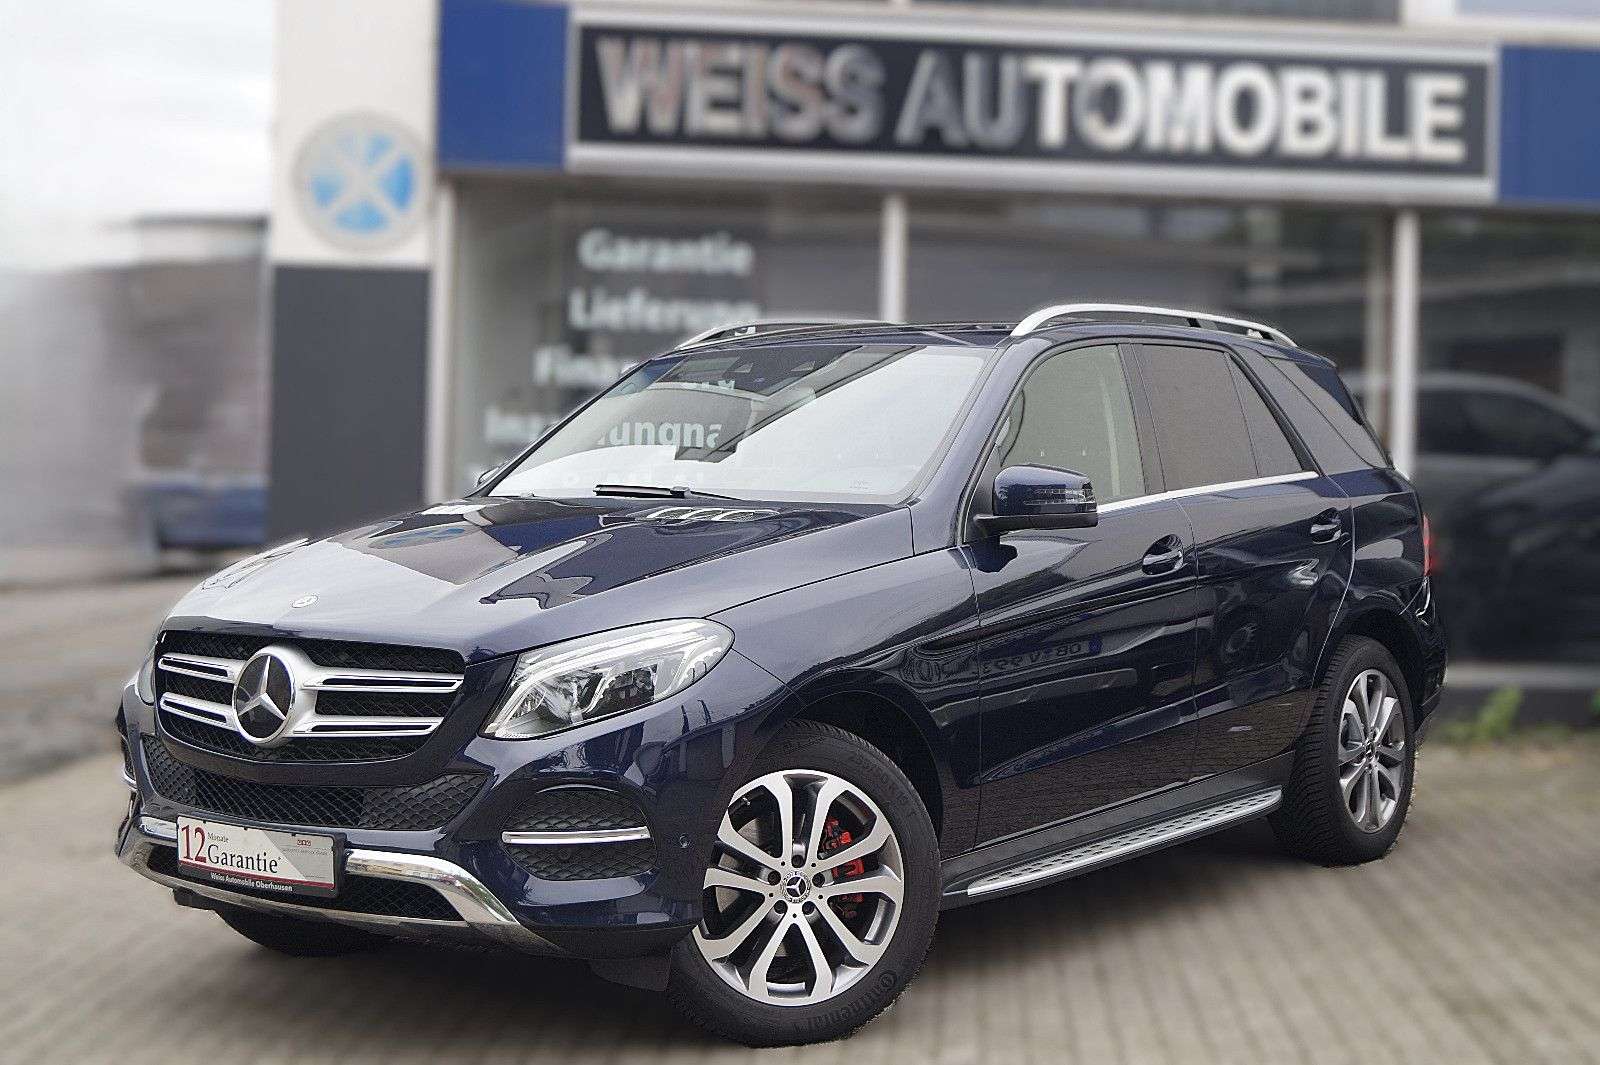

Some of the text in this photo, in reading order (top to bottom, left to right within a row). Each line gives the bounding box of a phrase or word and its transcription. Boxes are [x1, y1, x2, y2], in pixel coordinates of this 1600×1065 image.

[596, 36, 1469, 163] WEISS AUTOMOBILE
[578, 228, 754, 275] Garantie
[181, 824, 207, 863] 12
[210, 872, 293, 892] Weiss Automobile Oberhausen
